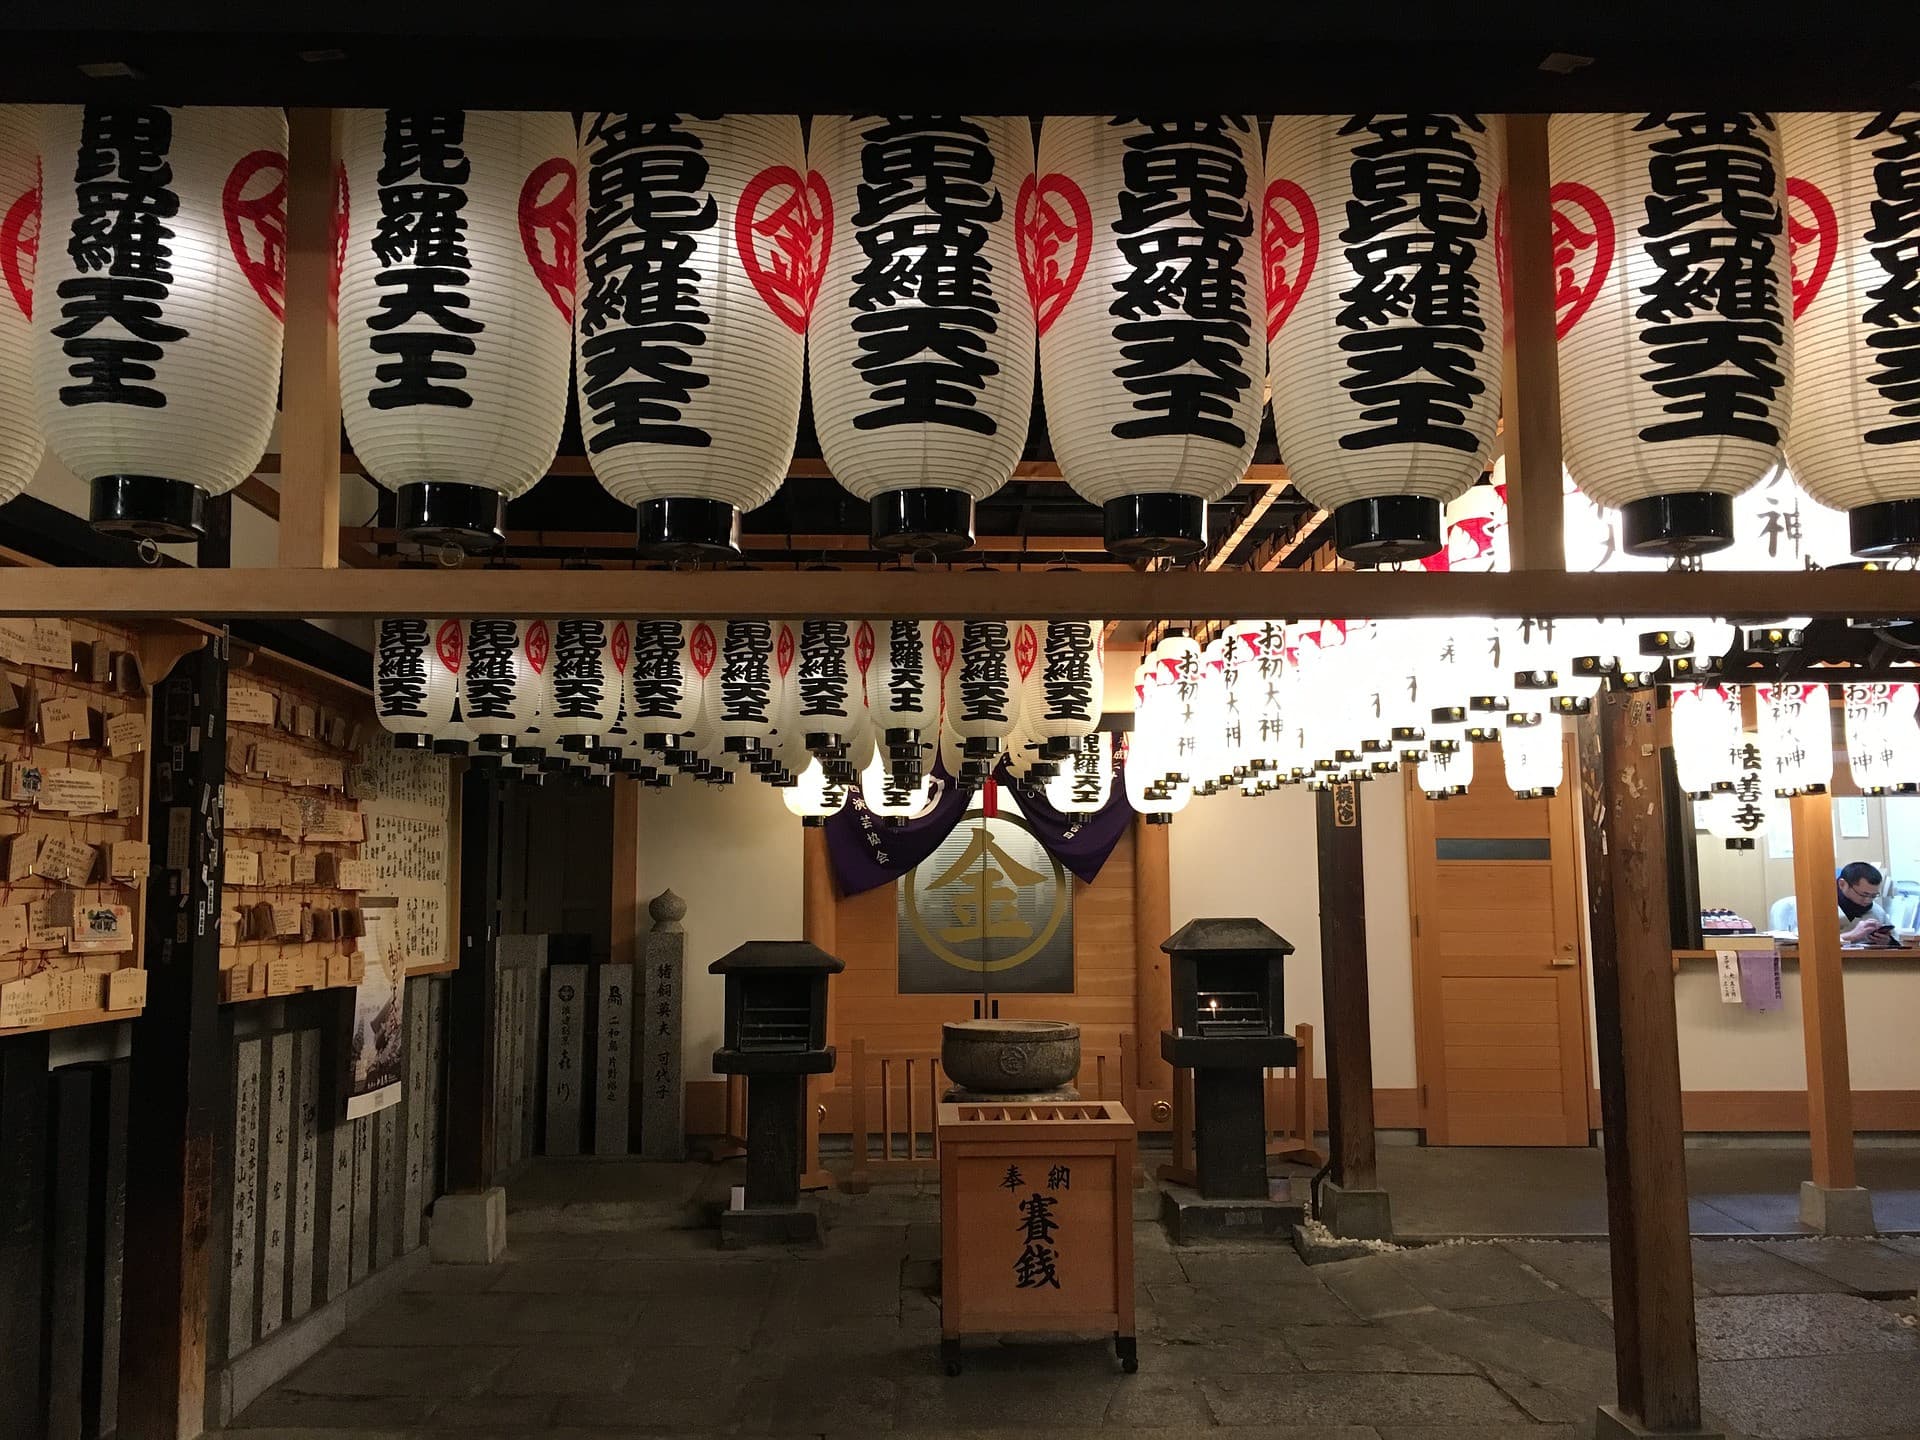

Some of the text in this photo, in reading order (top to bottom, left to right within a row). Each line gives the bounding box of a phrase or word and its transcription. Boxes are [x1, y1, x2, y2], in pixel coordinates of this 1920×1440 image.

[1177, 650, 1199, 756] お初大神
[1257, 622, 1284, 742] お初大神
[924, 828, 1049, 943] 金
[1000, 1165, 1071, 1192] 奉納
[1012, 1193, 1061, 1289] 賽銭
